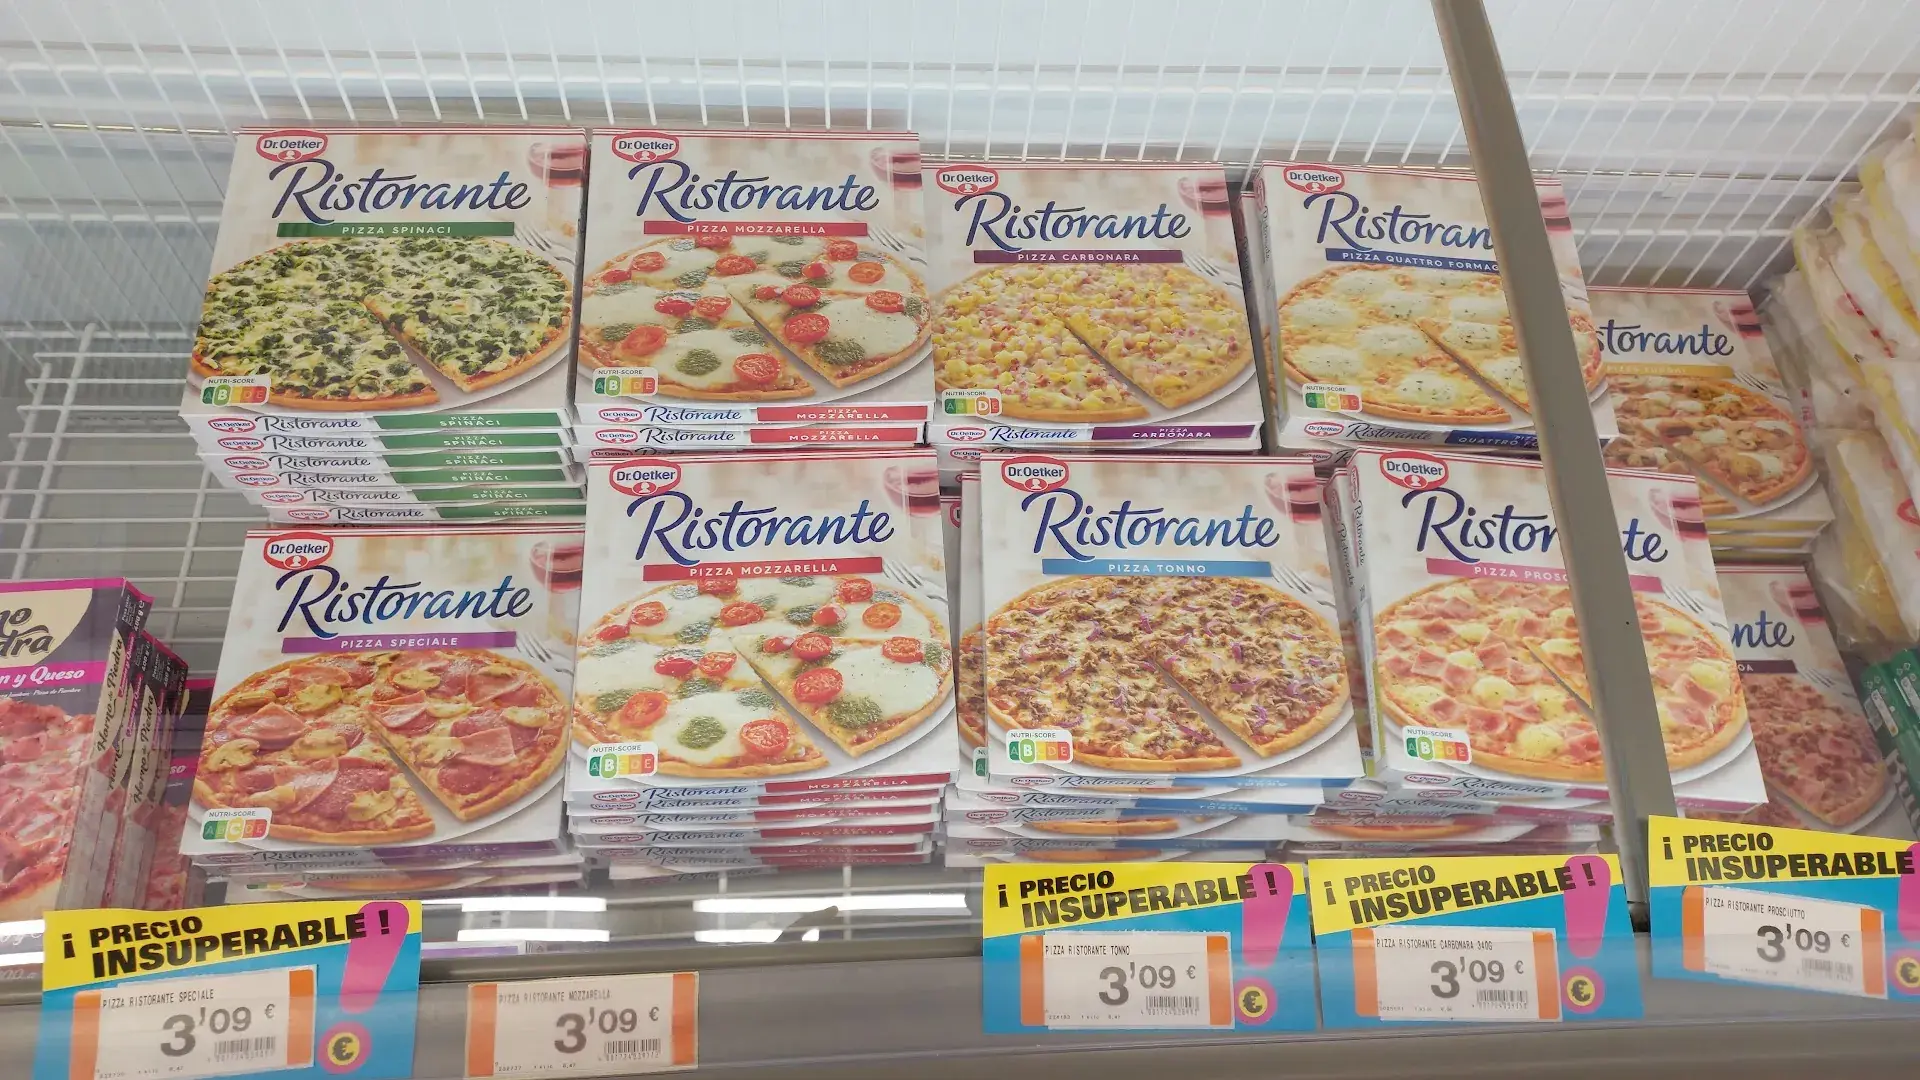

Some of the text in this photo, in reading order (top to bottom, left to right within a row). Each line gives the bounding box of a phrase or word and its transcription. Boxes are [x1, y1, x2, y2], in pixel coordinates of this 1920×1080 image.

[268, 158, 531, 225] Ristorante
[628, 159, 879, 223] Ristorante
[955, 191, 1191, 252] Ristorante
[1303, 191, 1494, 252] Ristoran
[342, 226, 451, 234] PIZZA SPINACI
[735, 226, 825, 234] MOZZARELLA
[1342, 252, 1380, 262] PIZZA
[1387, 256, 1443, 267] QUATTRO
[1596, 319, 1734, 355] torante
[644, 406, 741, 423] Ristorante
[255, 416, 361, 431] Ristorante
[640, 427, 735, 444] Ristorante
[989, 426, 1077, 441] Ristorante
[1348, 423, 1432, 441] Ristorante
[263, 435, 367, 450] Ristorante
[1459, 437, 1518, 445] QUATTRO
[269, 454, 371, 470] Ristorante
[279, 471, 378, 486] Ristorante
[304, 489, 400, 503] Ristorante
[330, 507, 423, 521] Ristorante
[627, 490, 894, 565] Ristorante
[1021, 487, 1280, 561] Ristorante
[1402, 486, 1668, 564] Ristorte
[690, 563, 837, 576] PIZZA MOZZARELLA
[1109, 564, 1206, 573] PIZZA TONNO
[1474, 566, 1569, 582] PIZZA PROSC
[275, 565, 533, 639] Ristorante
[341, 637, 458, 648] PIZZA SPECIALE
[107, 640, 122, 688] Piedra
[12, 674, 26, 688] y
[30, 666, 85, 684] Queso
[1407, 729, 1452, 738] NUTRI-SCORE
[592, 744, 642, 752] NUTRI-SCORE
[809, 780, 908, 789] MOZZARELLA
[1059, 775, 1157, 787] Ristorante
[1452, 777, 1553, 793] Ristorante
[643, 786, 748, 800] Ristorante
[1023, 793, 1119, 805] Ristorante
[638, 800, 741, 809] Ristorante
[638, 814, 737, 824] Ristorante
[1012, 808, 1107, 819] Ristorante
[646, 831, 744, 842] Ristorante
[1683, 833, 1773, 853] PRECIO
[1686, 851, 1915, 881] INSUPERABLE
[1020, 871, 1115, 898] PRECIO
[1345, 865, 1436, 896] PRECIO
[1021, 874, 1256, 928] INSUPERABLE
[1350, 866, 1576, 924] INSUPERABLE
[1706, 897, 1805, 919] PIZZA RISTORANTE PROSCIUTTO
[89, 916, 203, 948] PRECIO
[92, 912, 367, 978] INSUPERABLE
[1377, 939, 1396, 949] PIZZA
[1399, 939, 1436, 949] RISTORANTE
[1841, 934, 1850, 947] €
[1045, 946, 1130, 955] PIZZA RISTORANTE TONNO
[1187, 966, 1196, 979] €
[1515, 961, 1524, 973] €
[102, 989, 214, 1008] PIZZA RISTORANTE SPECIALE
[499, 993, 520, 1003] PIZZA
[523, 992, 564, 1003] RISTORANTE
[264, 1004, 275, 1018] €
[649, 1007, 659, 1021] €
